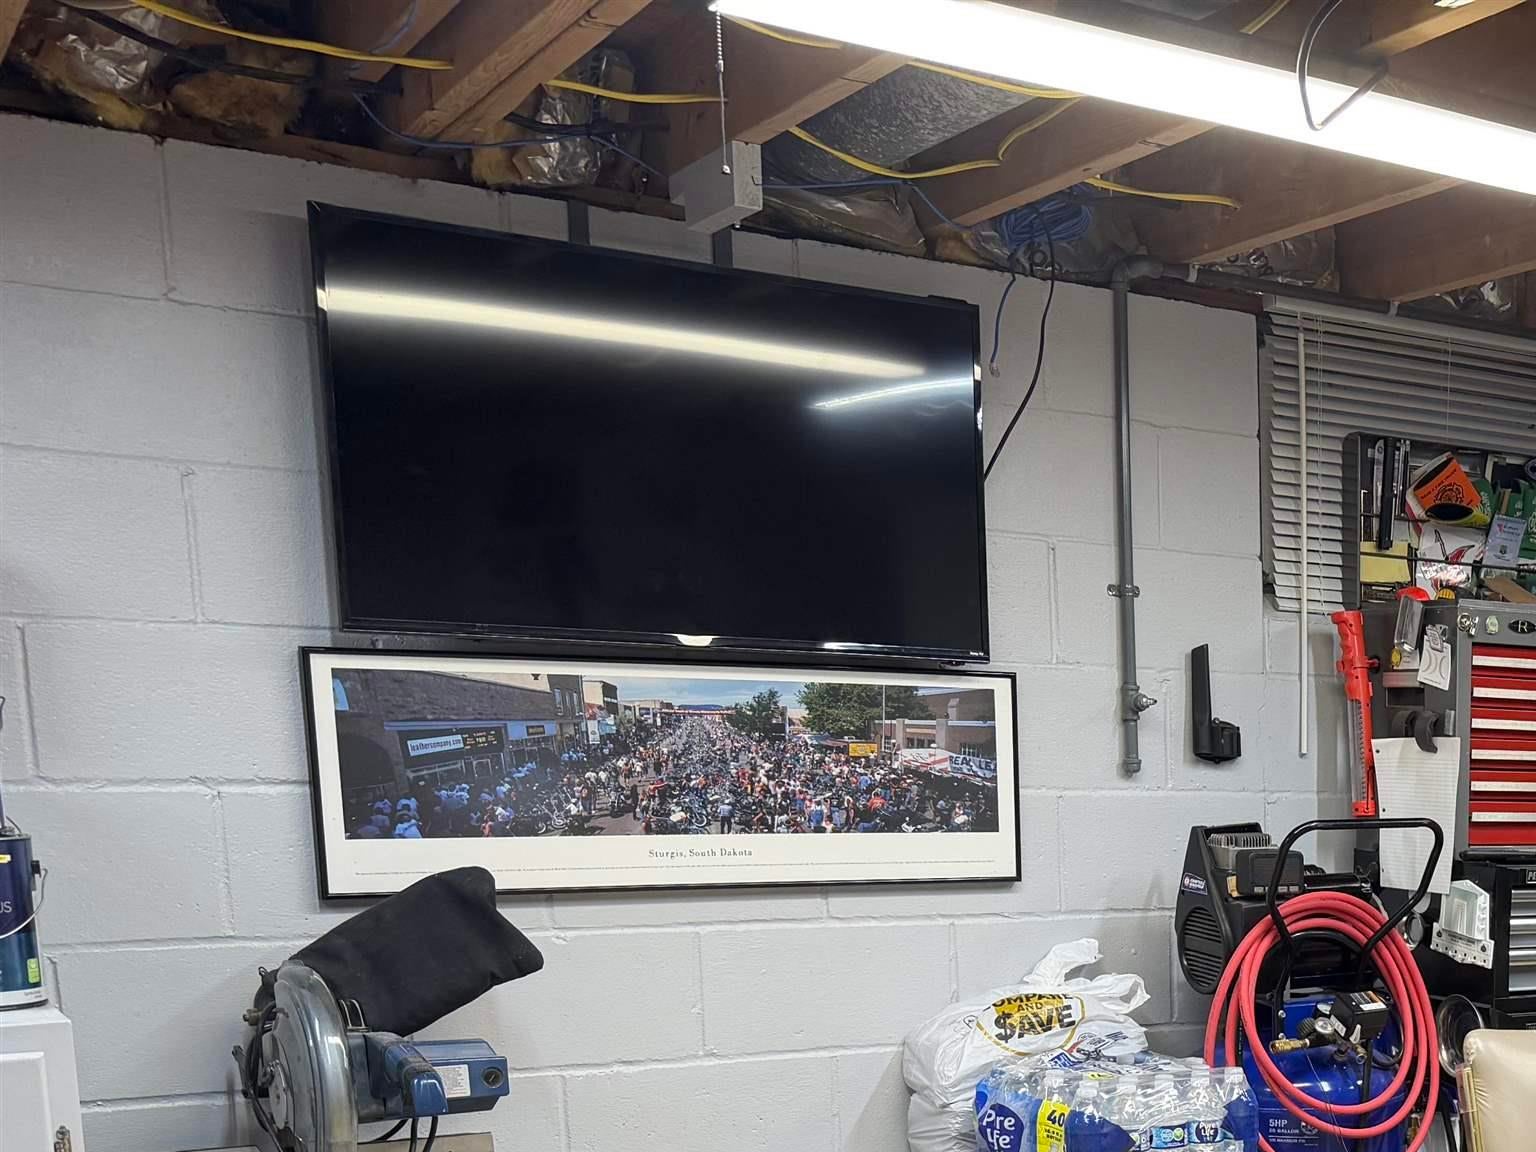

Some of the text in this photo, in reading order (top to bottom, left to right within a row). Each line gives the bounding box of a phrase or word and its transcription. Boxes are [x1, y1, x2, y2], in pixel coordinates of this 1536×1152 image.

[648, 848, 752, 859] Sturgis, South Dakota
[990, 993, 1074, 1010] OMPARE
[1017, 1002, 1043, 1013] AND
[1046, 1109, 1066, 1127] 40
[1269, 1119, 1288, 1127] 5HP
